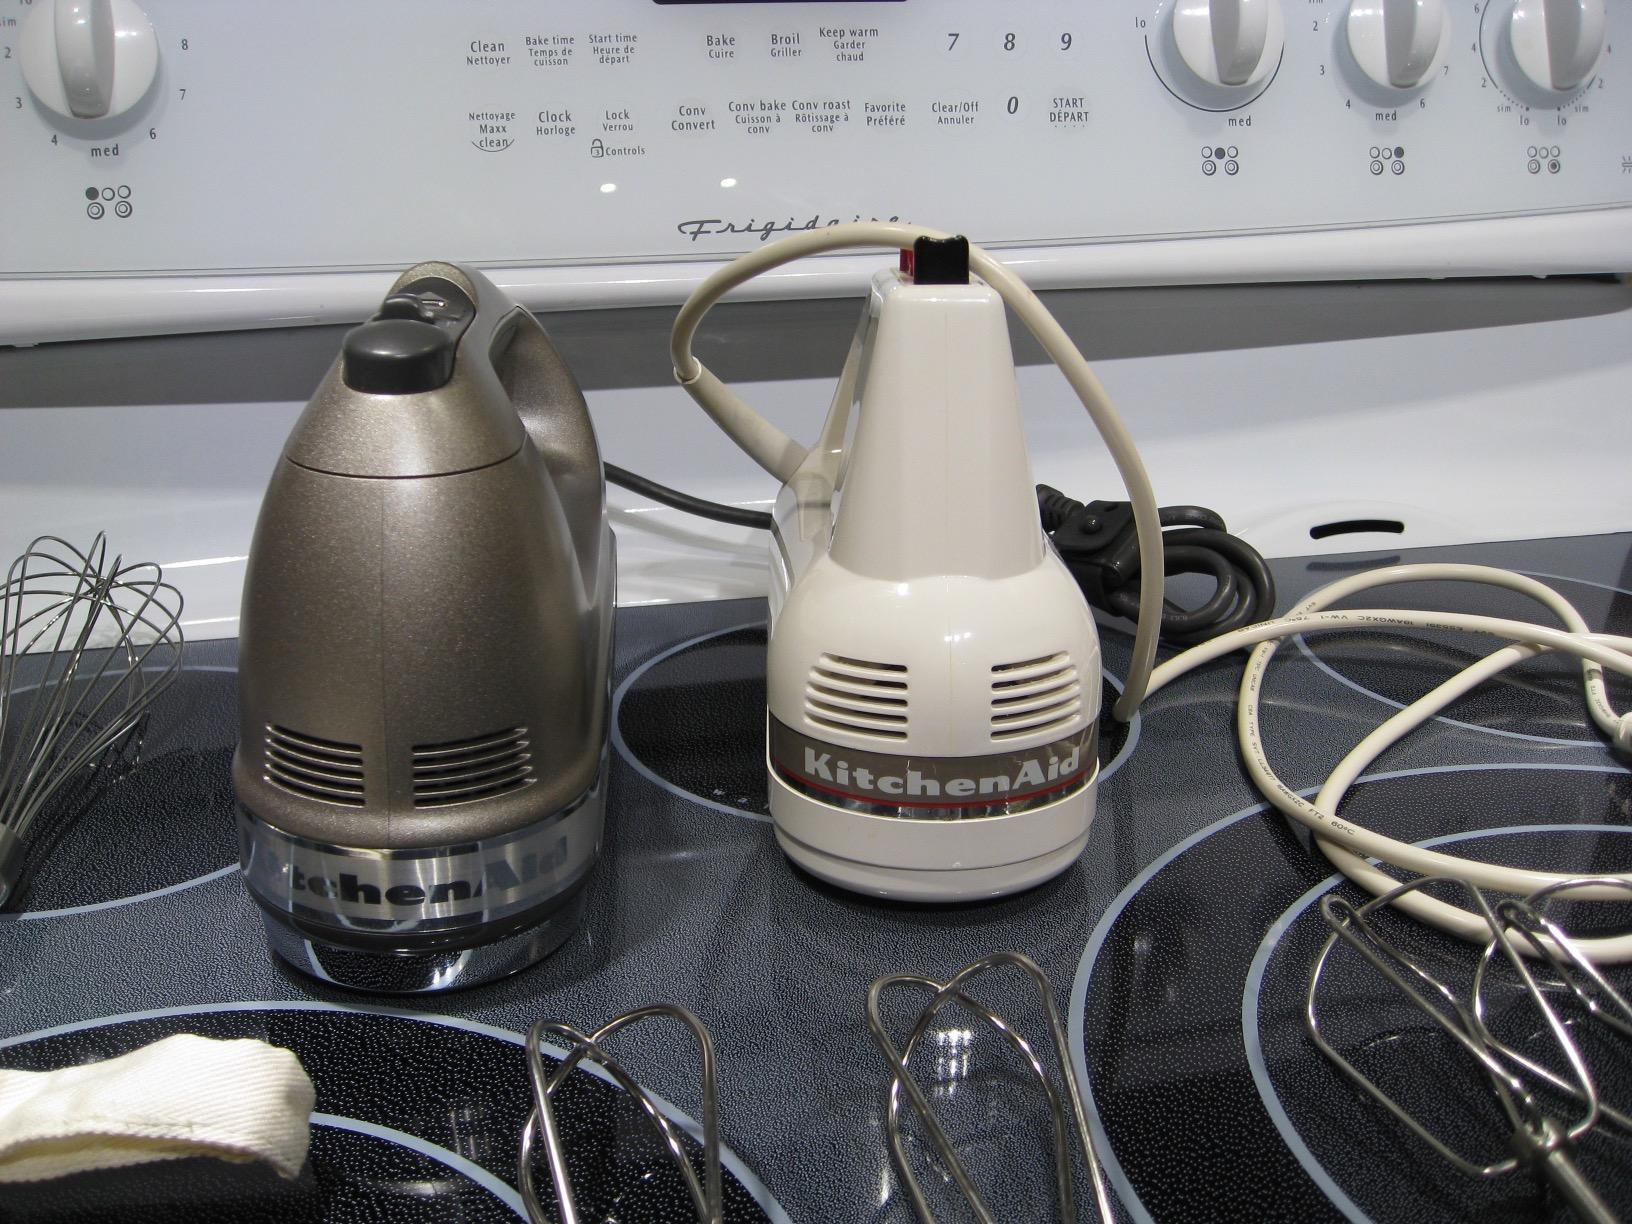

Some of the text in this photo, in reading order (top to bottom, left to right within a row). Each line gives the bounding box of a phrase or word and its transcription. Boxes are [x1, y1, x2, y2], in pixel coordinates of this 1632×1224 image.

[0, 17, 17, 27] im
[1136, 17, 1146, 28] lo
[1312, 20, 1319, 31] 2
[589, 33, 637, 43] Start time
[820, 27, 878, 39] Keep warm
[180, 38, 189, 50] 8
[526, 35, 574, 45] Bake time
[707, 34, 735, 46] Bake
[771, 33, 799, 45] Broil
[834, 40, 865, 49] Garder
[948, 33, 959, 51] 7
[1004, 33, 1015, 51] 8
[1061, 33, 1072, 50] 9
[471, 40, 504, 52] Clean
[593, 45, 634, 54] Heure de
[1471, 42, 1477, 52] 4
[4, 46, 13, 59] 2
[529, 47, 572, 59] Temps de
[709, 49, 734, 58] Cuire
[771, 47, 801, 57] Griller
[837, 51, 863, 61] chaud
[467, 54, 510, 66] Nettoyer
[534, 57, 568, 66] cuisson
[599, 54, 630, 65] départ
[1319, 64, 1326, 75] 3
[1443, 65, 1449, 75] 7
[1481, 76, 1488, 88] 2
[178, 88, 187, 100] 7
[15, 97, 23, 109] 3
[729, 100, 786, 112] Conv bake
[792, 100, 850, 111] Conv roast
[865, 102, 905, 112] Favorite
[932, 101, 978, 112] Clear/Off
[1053, 98, 1084, 108] START
[1345, 98, 1351, 109] 4
[1419, 97, 1426, 108] 6
[469, 112, 515, 121] Nettoyage
[539, 110, 572, 123] Clock
[606, 109, 630, 120] Lock
[679, 106, 705, 116] Conv
[1050, 109, 1089, 122] DÉPART
[1376, 110, 1396, 121] med
[735, 112, 781, 124] Cuisson à
[796, 112, 849, 124] Rôtissage à
[867, 115, 905, 126] Préféré
[938, 114, 974, 124] Annuler
[1229, 115, 1251, 126] med
[1520, 115, 1529, 126] lo
[1558, 115, 1567, 126] lo
[480, 124, 506, 134] Maxx
[537, 125, 575, 136] Horloge
[603, 123, 633, 131] Verrou
[672, 120, 715, 131] Convert
[149, 127, 157, 139] 6
[50, 134, 58, 146] 4
[479, 137, 508, 148] clean
[91, 144, 119, 157] med
[606, 146, 645, 156] Controls
[804, 746, 1080, 797] KitchenAid
